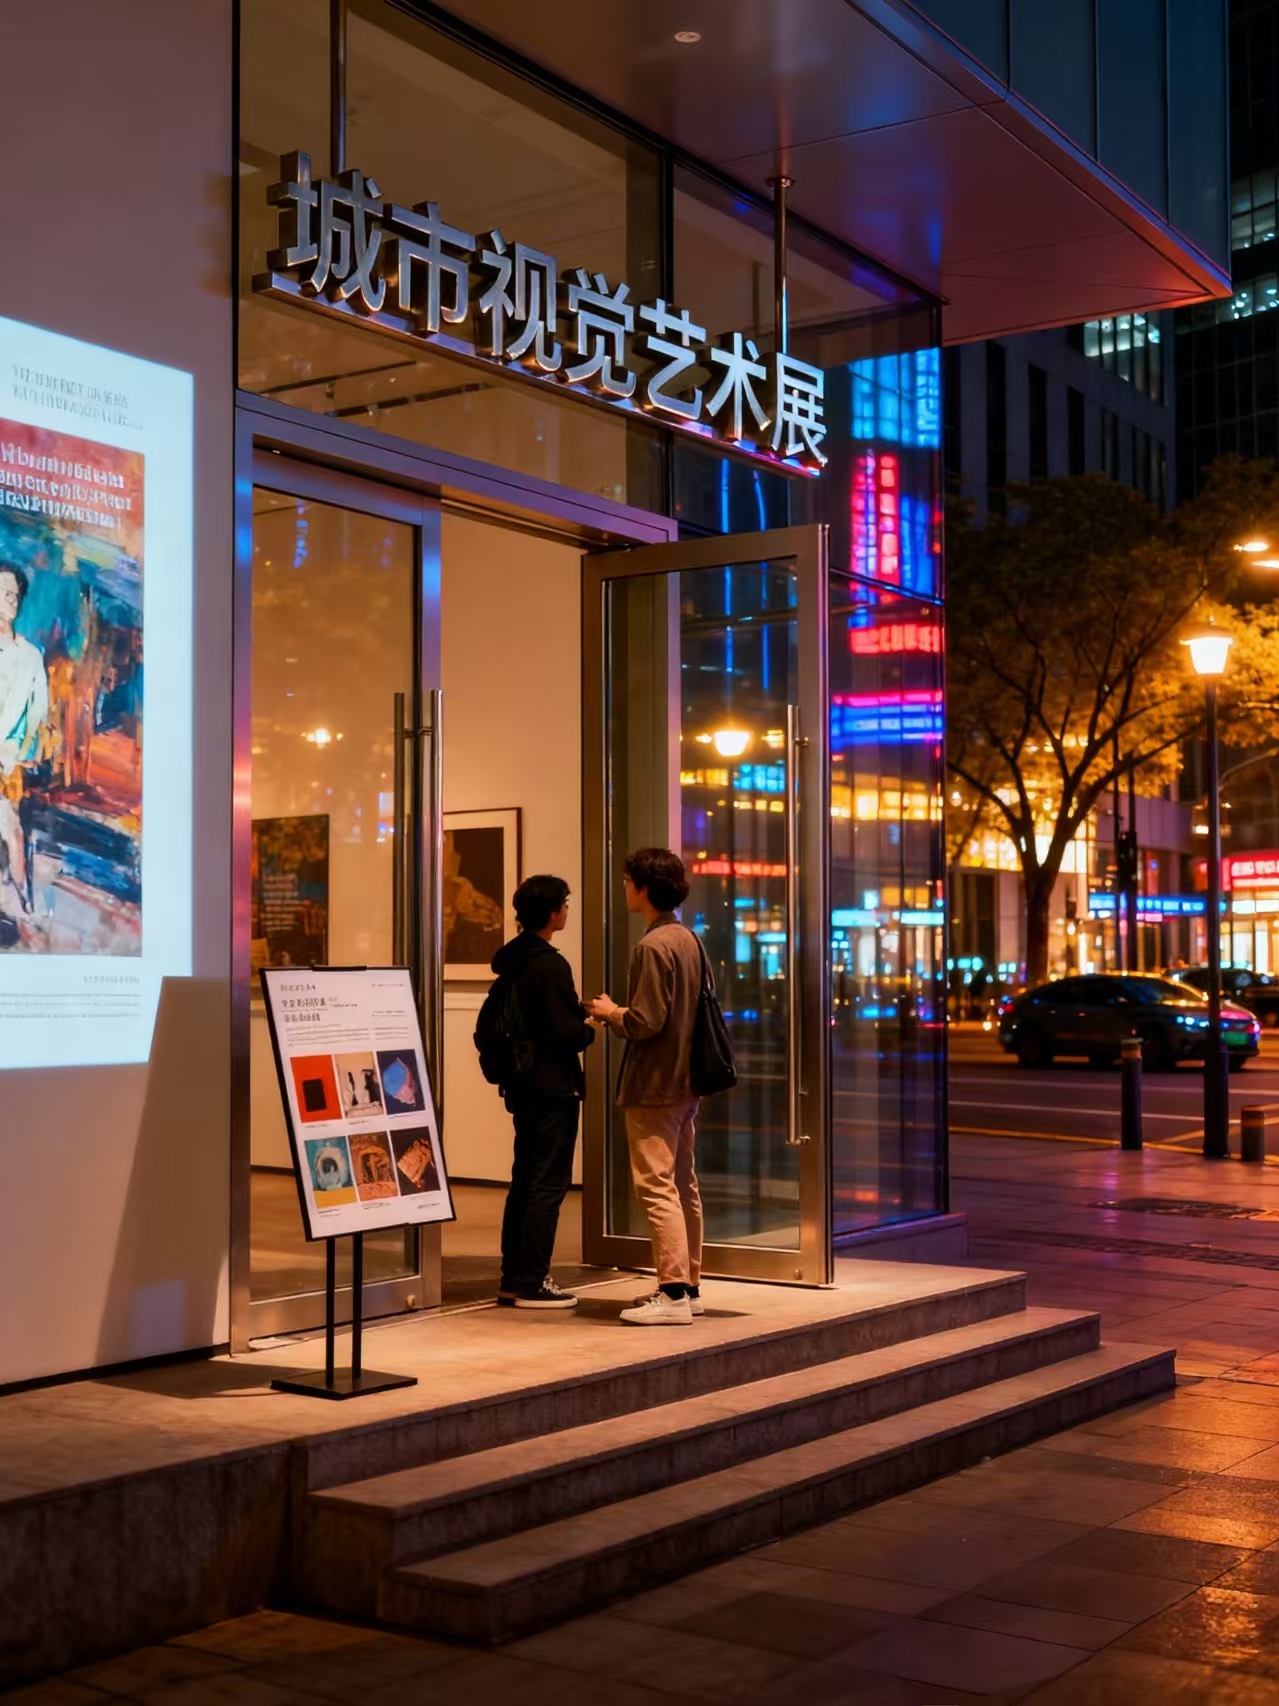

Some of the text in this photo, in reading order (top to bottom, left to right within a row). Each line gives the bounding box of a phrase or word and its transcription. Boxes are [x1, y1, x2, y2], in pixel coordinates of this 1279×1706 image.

[283, 151, 828, 466] 城市视觉艺术展
